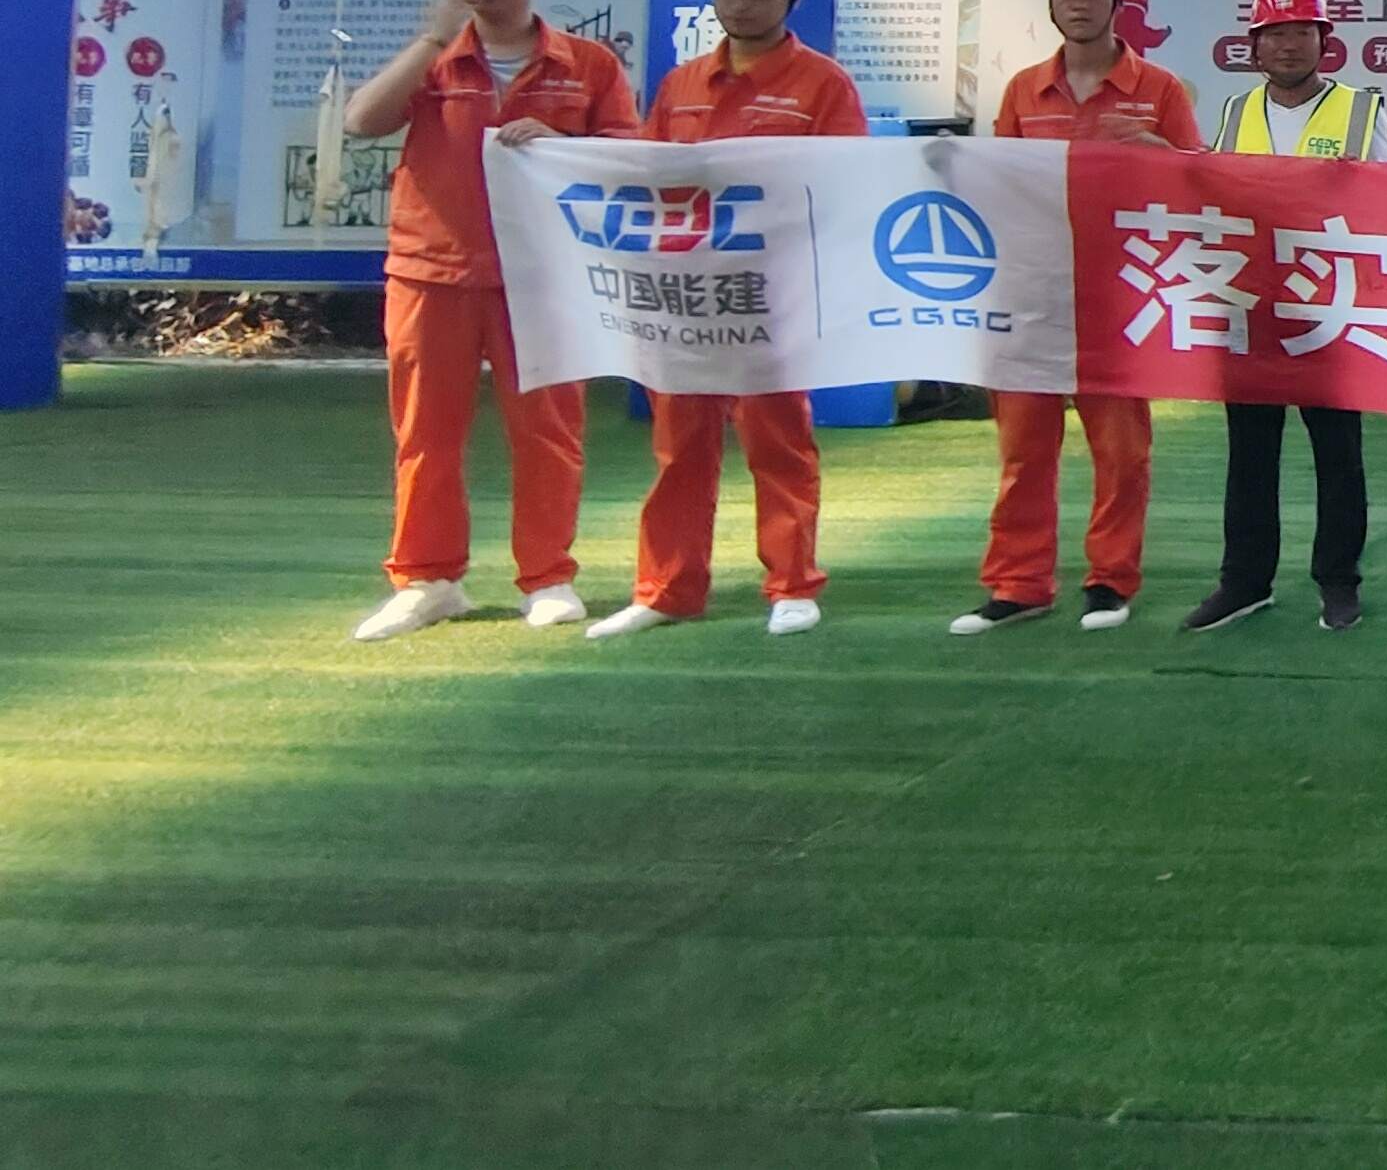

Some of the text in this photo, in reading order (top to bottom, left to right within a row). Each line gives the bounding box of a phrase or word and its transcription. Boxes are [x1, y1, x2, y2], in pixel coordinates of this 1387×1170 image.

[587, 261, 770, 318] 中国能建
[600, 311, 771, 345] ENERGY CHINA
[867, 306, 1012, 333] CGGC
